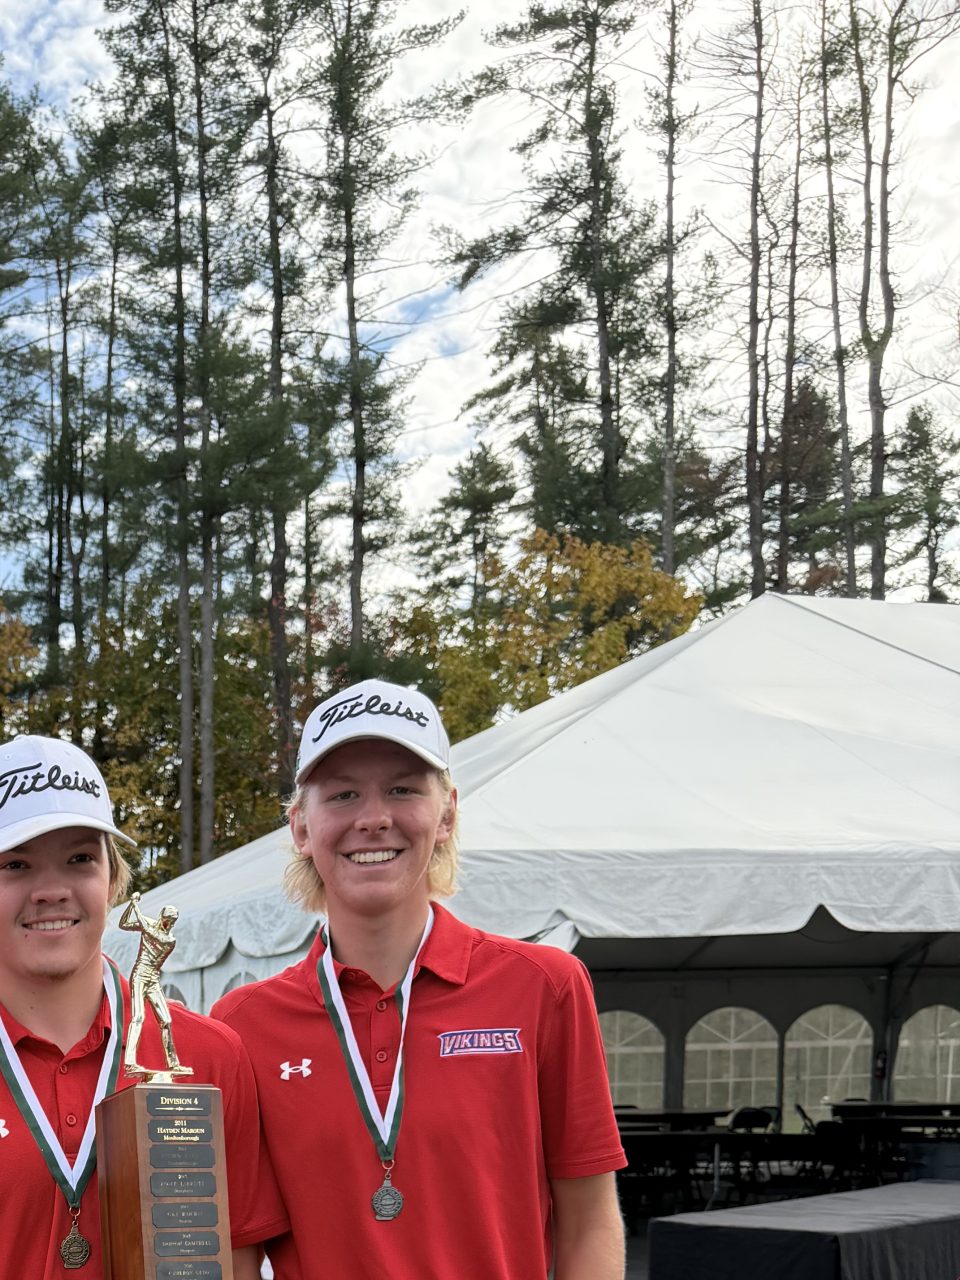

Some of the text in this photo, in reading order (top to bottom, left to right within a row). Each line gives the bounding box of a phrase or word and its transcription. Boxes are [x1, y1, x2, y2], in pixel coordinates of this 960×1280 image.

[312, 694, 429, 743] Titleist
[444, 1032, 518, 1054] VIKINGS
[193, 1097, 199, 1105] 4
